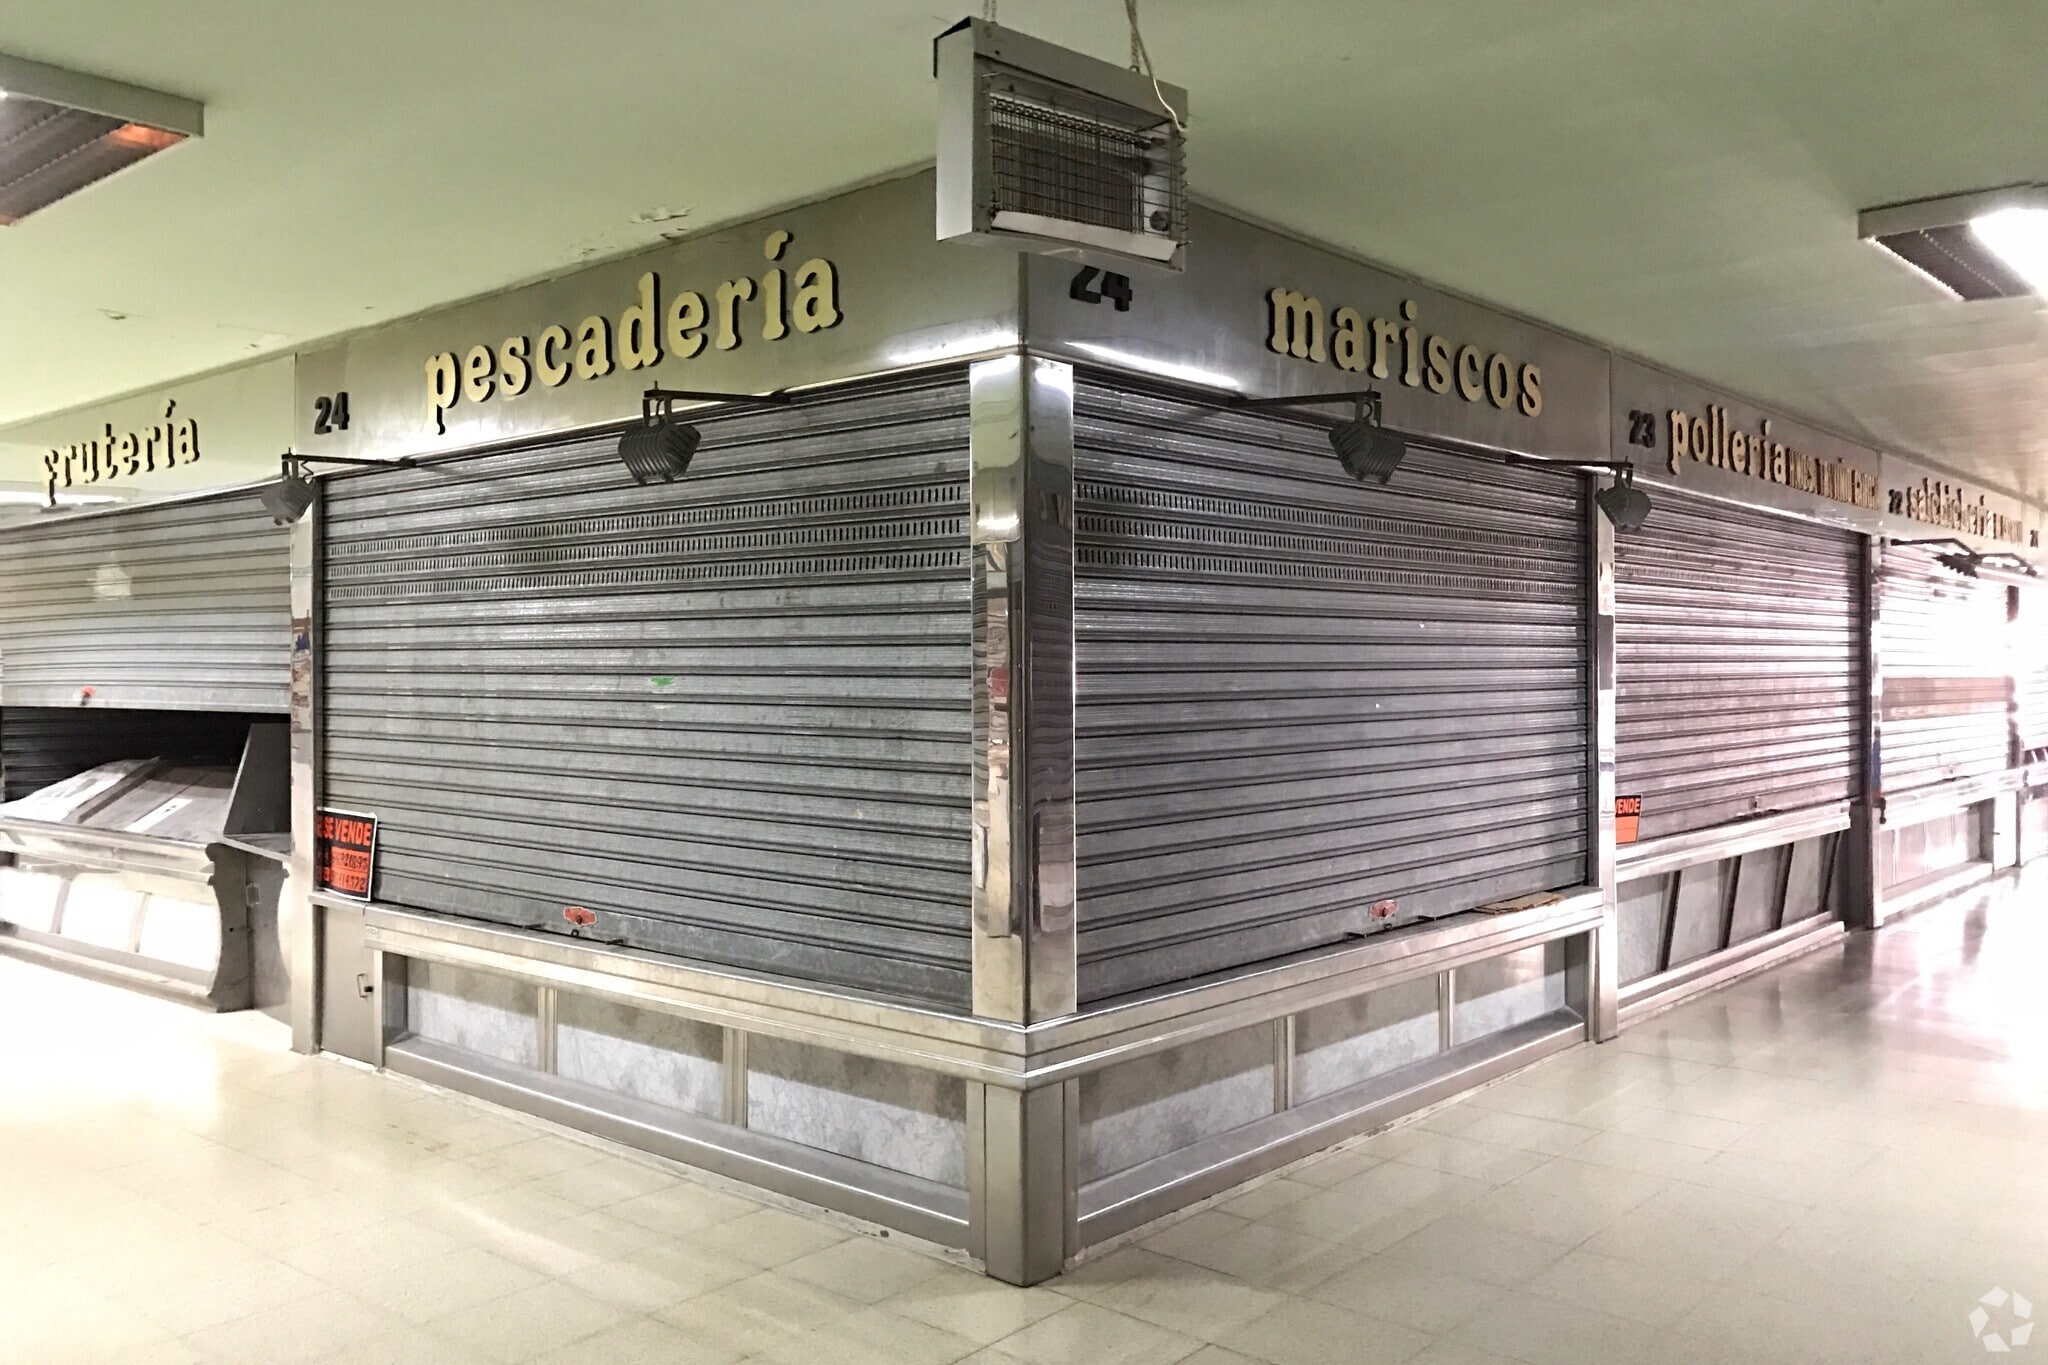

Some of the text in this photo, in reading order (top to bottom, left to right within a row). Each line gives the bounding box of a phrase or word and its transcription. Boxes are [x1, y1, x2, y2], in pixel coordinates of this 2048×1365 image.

[424, 229, 843, 435] pescadería
[1266, 287, 1542, 417] mariscos
[314, 391, 350, 435] 24
[1628, 410, 1656, 448] 23
[334, 818, 373, 846] VENDE
